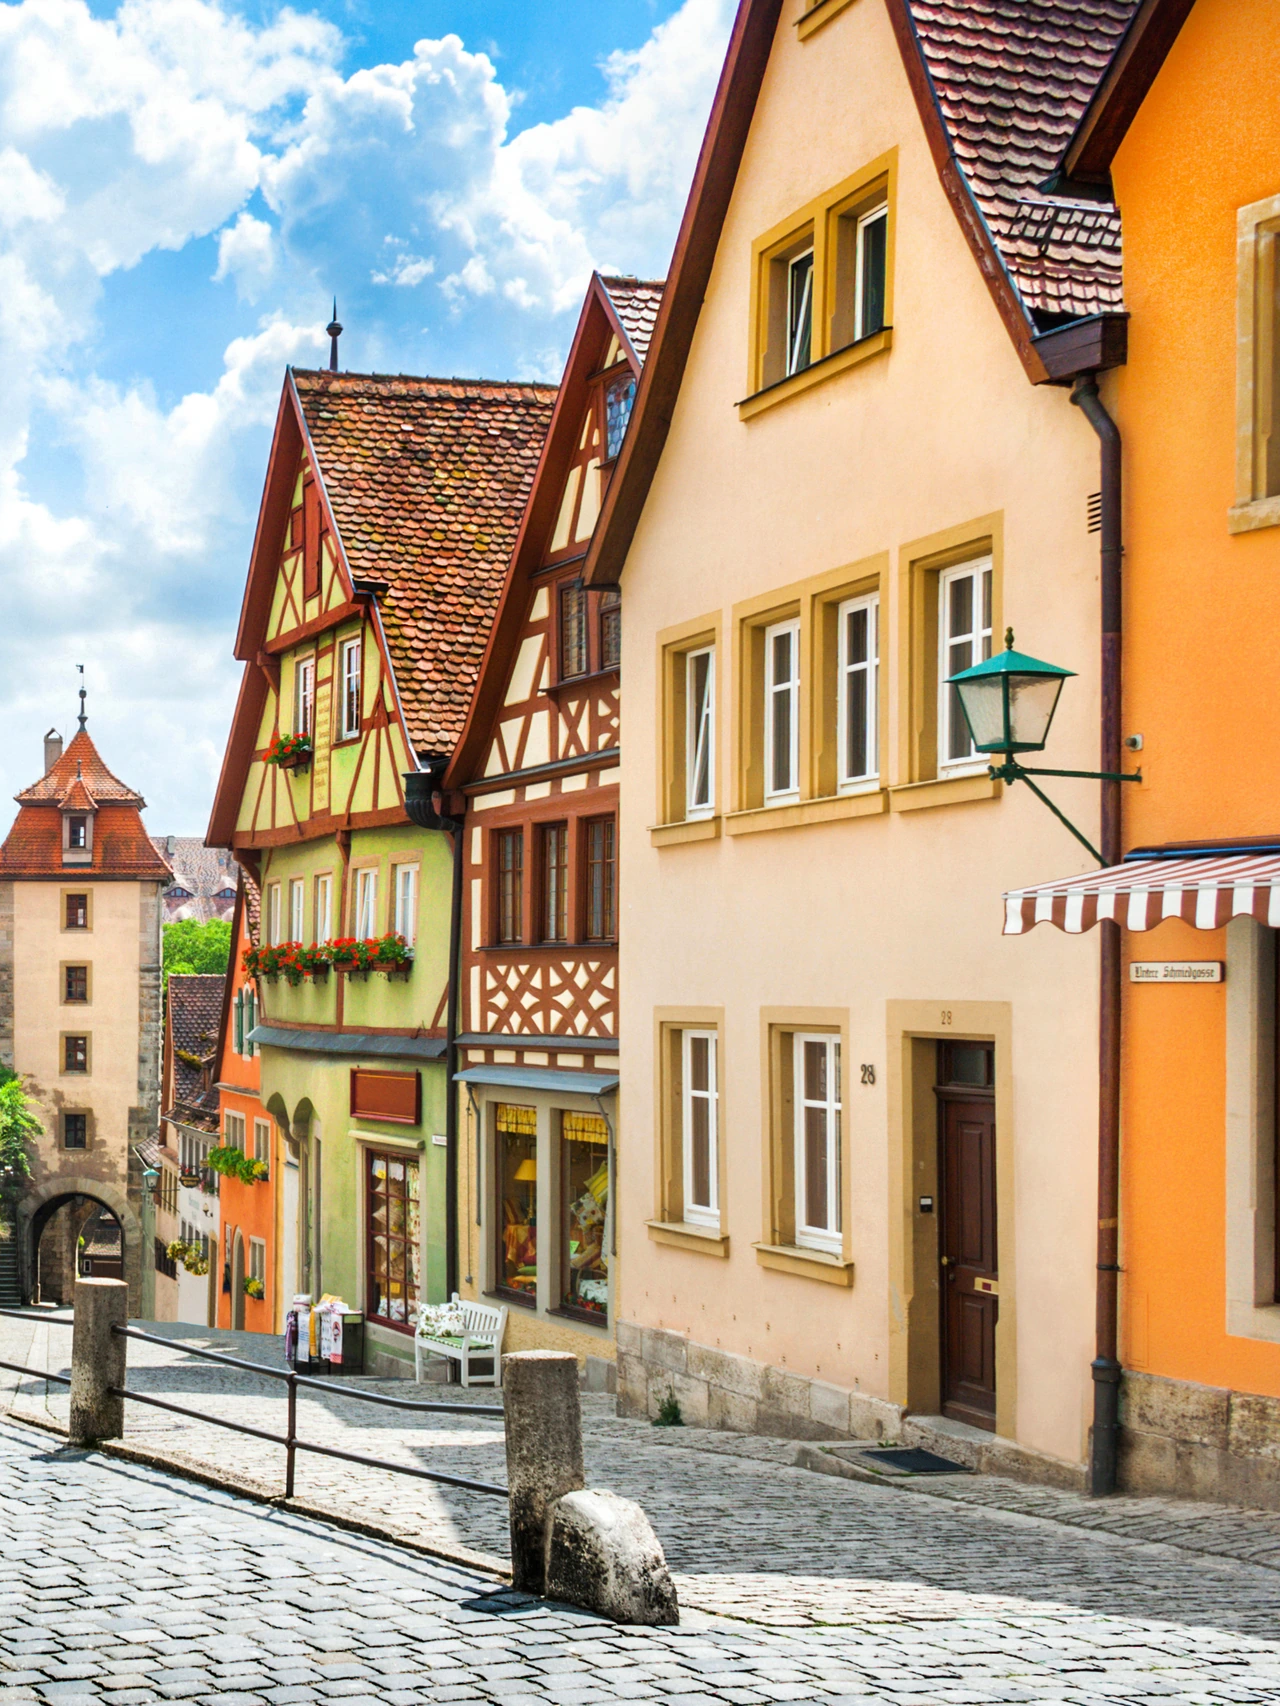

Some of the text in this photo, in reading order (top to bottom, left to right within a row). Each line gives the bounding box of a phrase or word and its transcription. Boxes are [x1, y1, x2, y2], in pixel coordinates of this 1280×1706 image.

[1135, 966, 1158, 978] Untere
[941, 1010, 952, 1025] 28
[860, 1063, 876, 1085] 28
